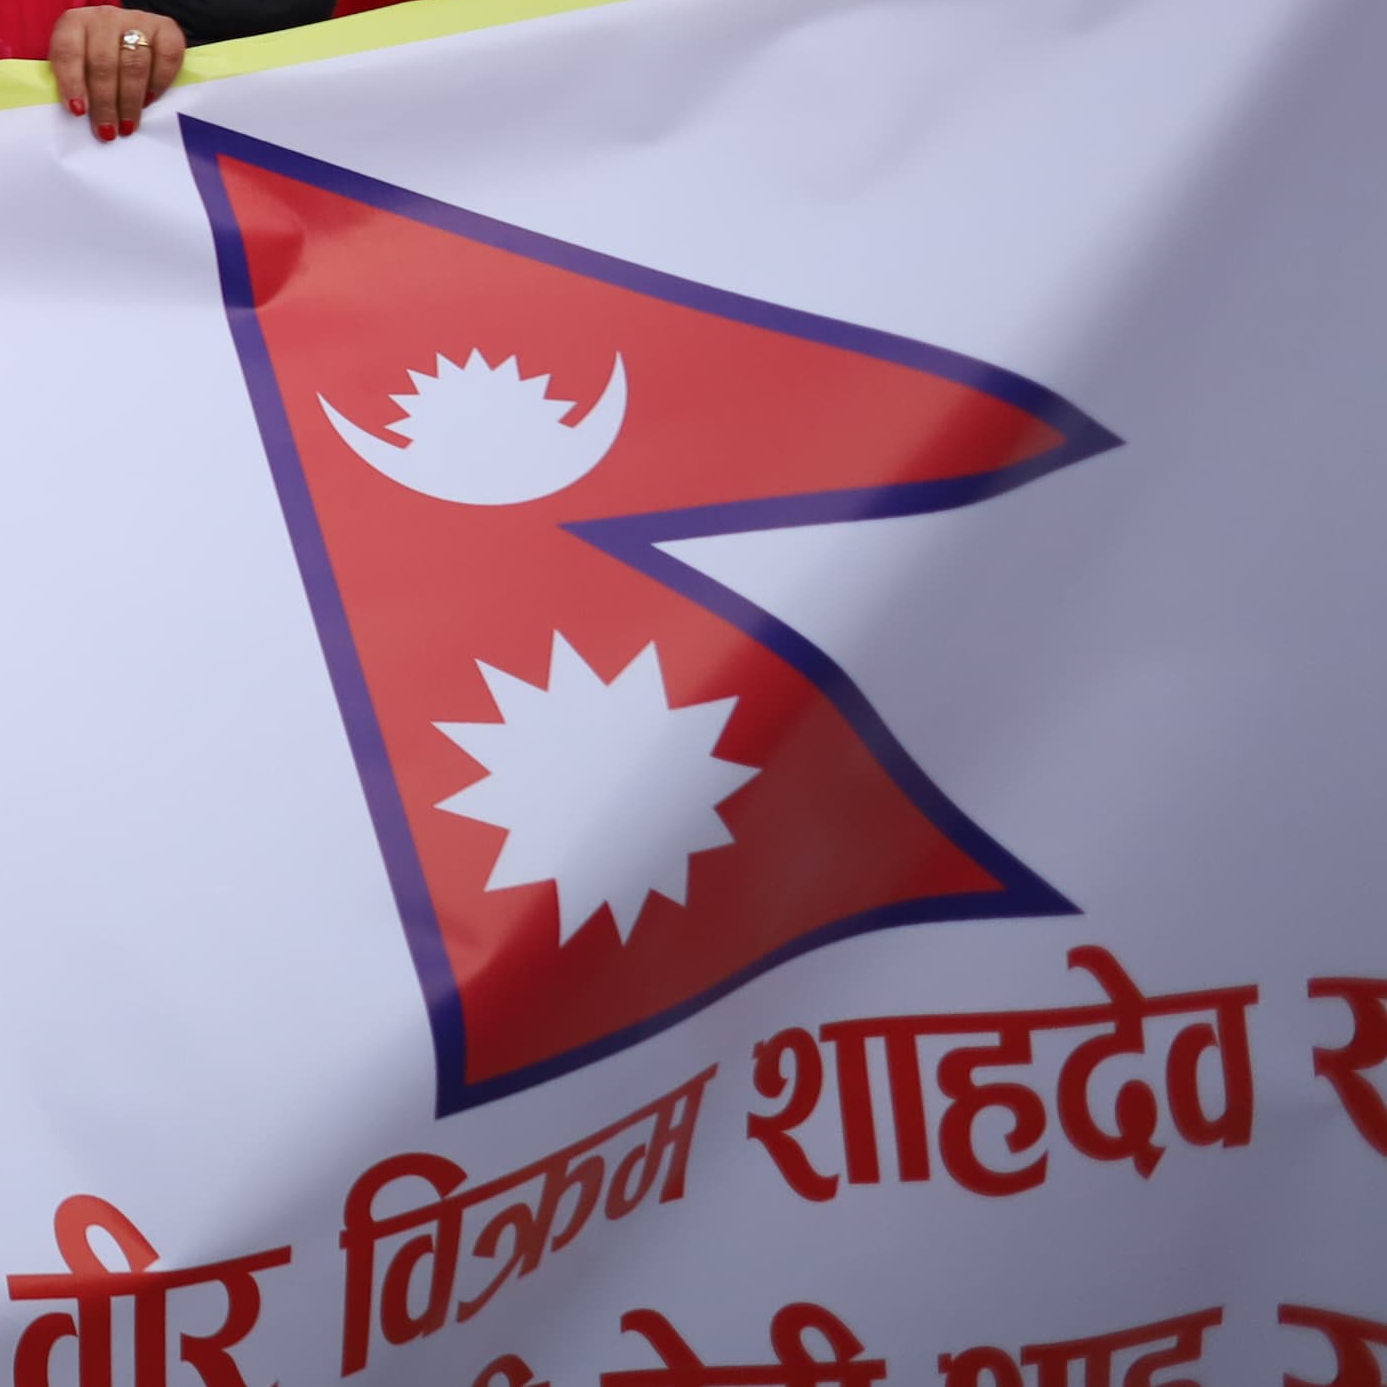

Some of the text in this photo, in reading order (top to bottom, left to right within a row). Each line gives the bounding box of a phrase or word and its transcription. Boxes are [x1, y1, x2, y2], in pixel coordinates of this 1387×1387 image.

[6, 1194, 292, 1387] वीर
[340, 1067, 719, 1377] विक्रम
[747, 946, 1259, 1200] शाहदेव
